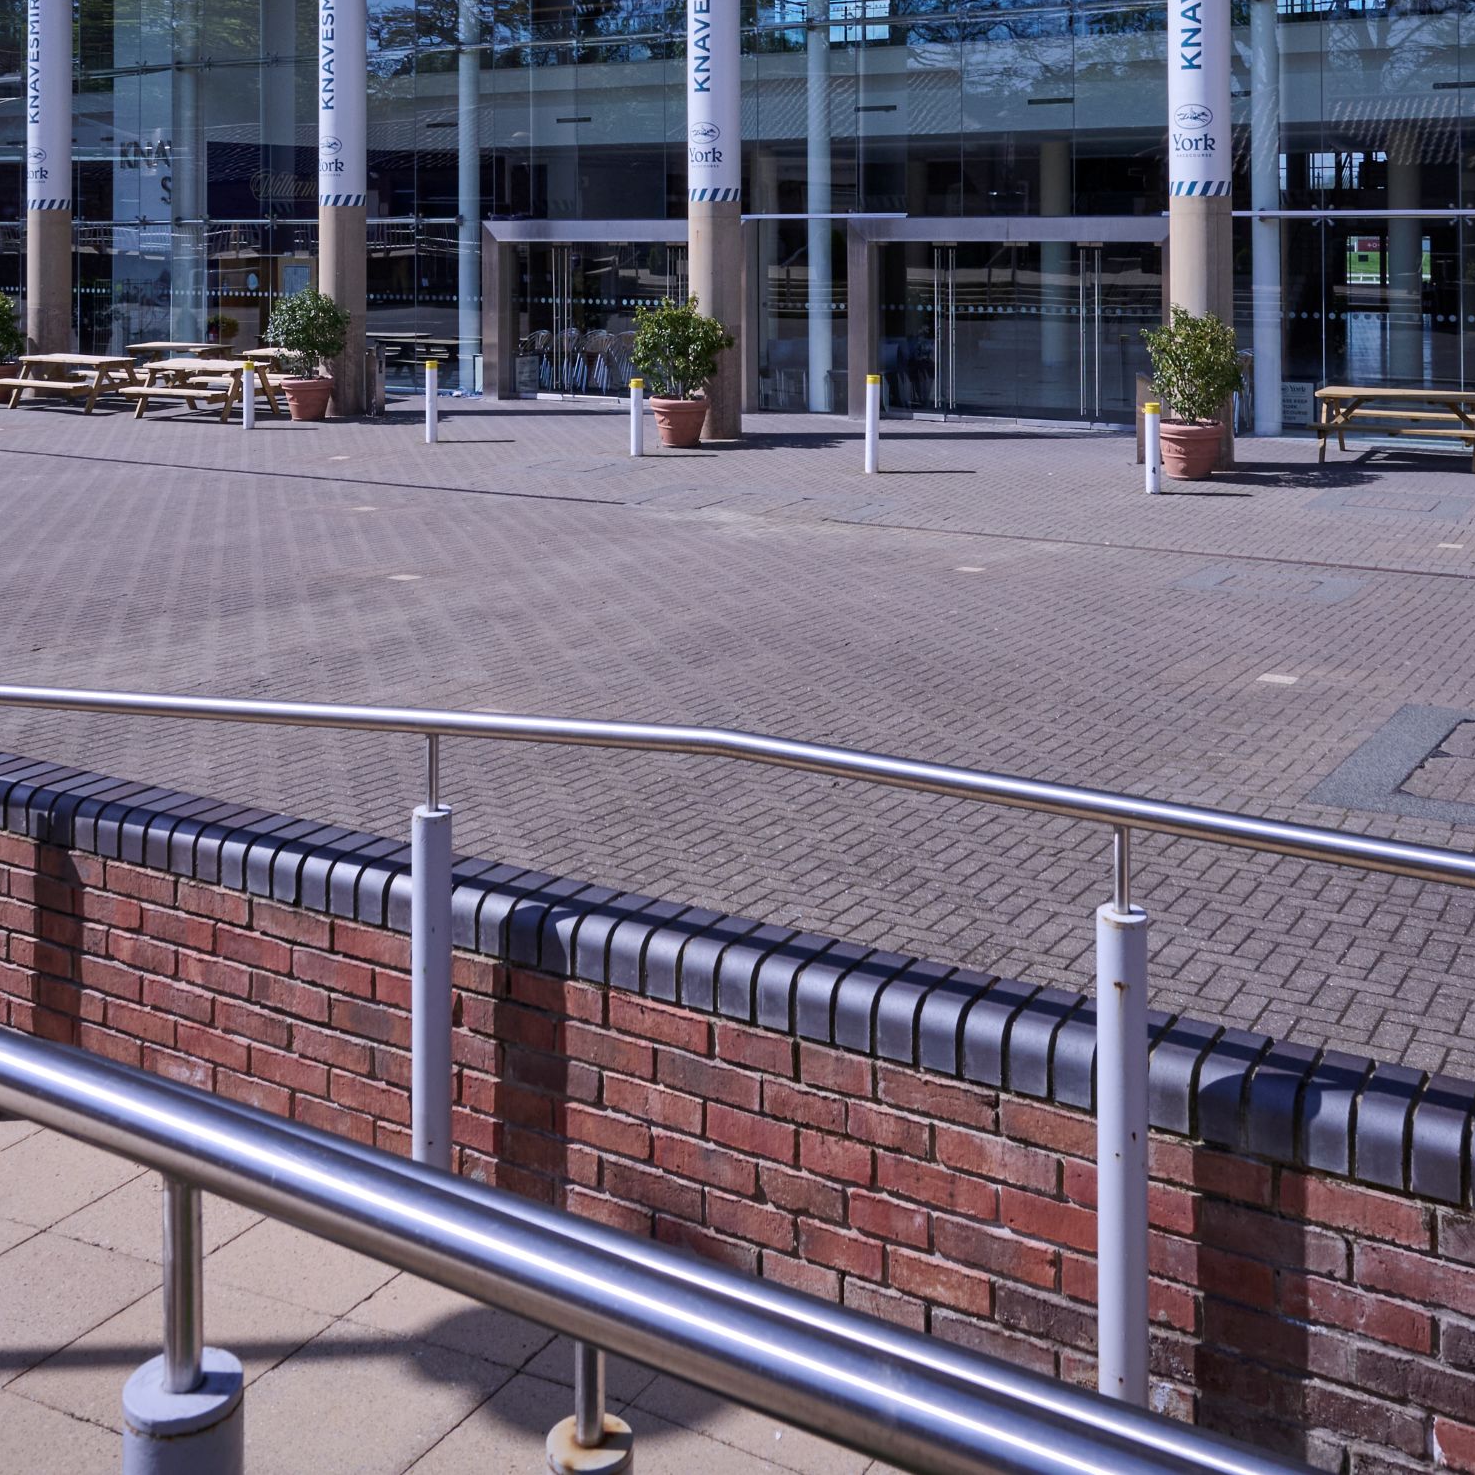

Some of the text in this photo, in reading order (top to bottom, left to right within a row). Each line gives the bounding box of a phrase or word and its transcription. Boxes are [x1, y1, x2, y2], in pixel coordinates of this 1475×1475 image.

[1173, 133, 1216, 151] York
[689, 147, 723, 163] York
[28, 167, 49, 179] ork
